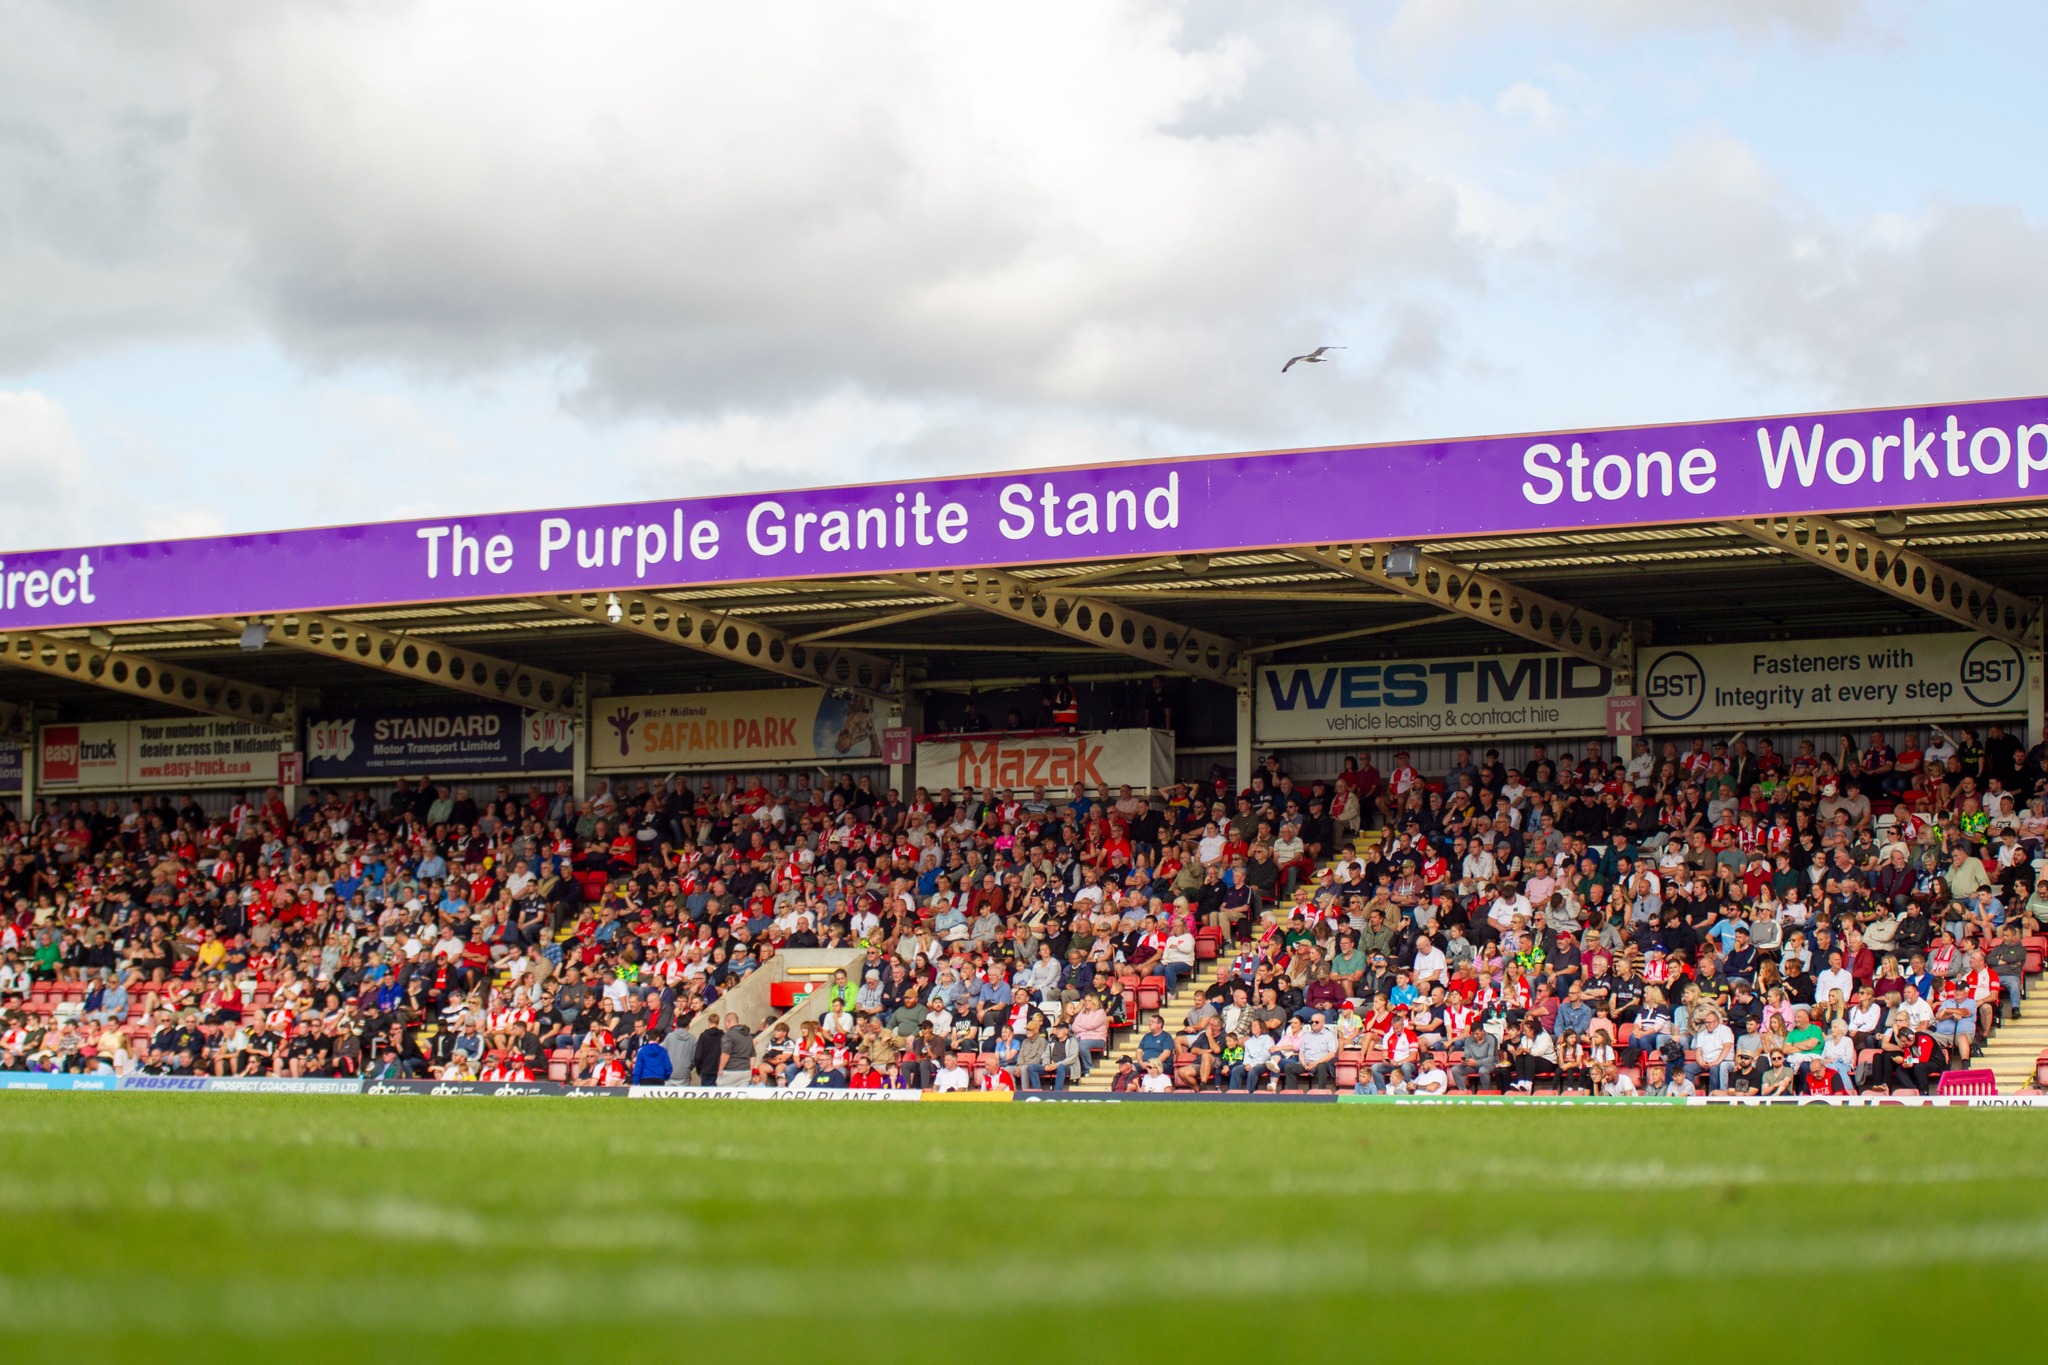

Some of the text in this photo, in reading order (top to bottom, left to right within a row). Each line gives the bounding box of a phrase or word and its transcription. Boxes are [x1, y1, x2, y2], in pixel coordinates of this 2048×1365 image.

[1522, 415, 2048, 505] Stone Worktop
[416, 470, 1179, 579] The Purple Granite Stand
[1752, 649, 1914, 675] Fasteners with
[1968, 659, 2017, 684] BST
[1264, 657, 1613, 712] WESTMID
[1653, 674, 1698, 699] BST
[1715, 678, 1953, 710] Integrity at every step
[643, 706, 708, 718] West Midlands
[1611, 699, 1637, 708] BLOCK
[373, 714, 501, 741] STANDARD
[533, 719, 568, 741] SMT
[1326, 706, 1559, 733] vehicle leasing & contract hire
[1615, 711, 1632, 731] K
[140, 724, 163, 740] Your
[165, 723, 205, 739] number
[316, 729, 350, 750] SMT
[642, 717, 798, 753] SAFARI PARK
[885, 730, 908, 739] BLOCK
[45, 738, 117, 766] easy truck
[140, 737, 282, 758] dealer across the Midlands
[373, 739, 501, 755] Motor Transport Limited
[891, 742, 903, 761] J
[140, 759, 252, 778] www.easy-truck.co.uk
[283, 765, 296, 782] H
[957, 737, 1105, 790] Mazak
[124, 1076, 208, 1090] PROSPECT
[210, 1081, 359, 1093] PROSPECT COACHES (WEST) LTD
[367, 1081, 397, 1096] ebc
[430, 1082, 460, 1096] ebc
